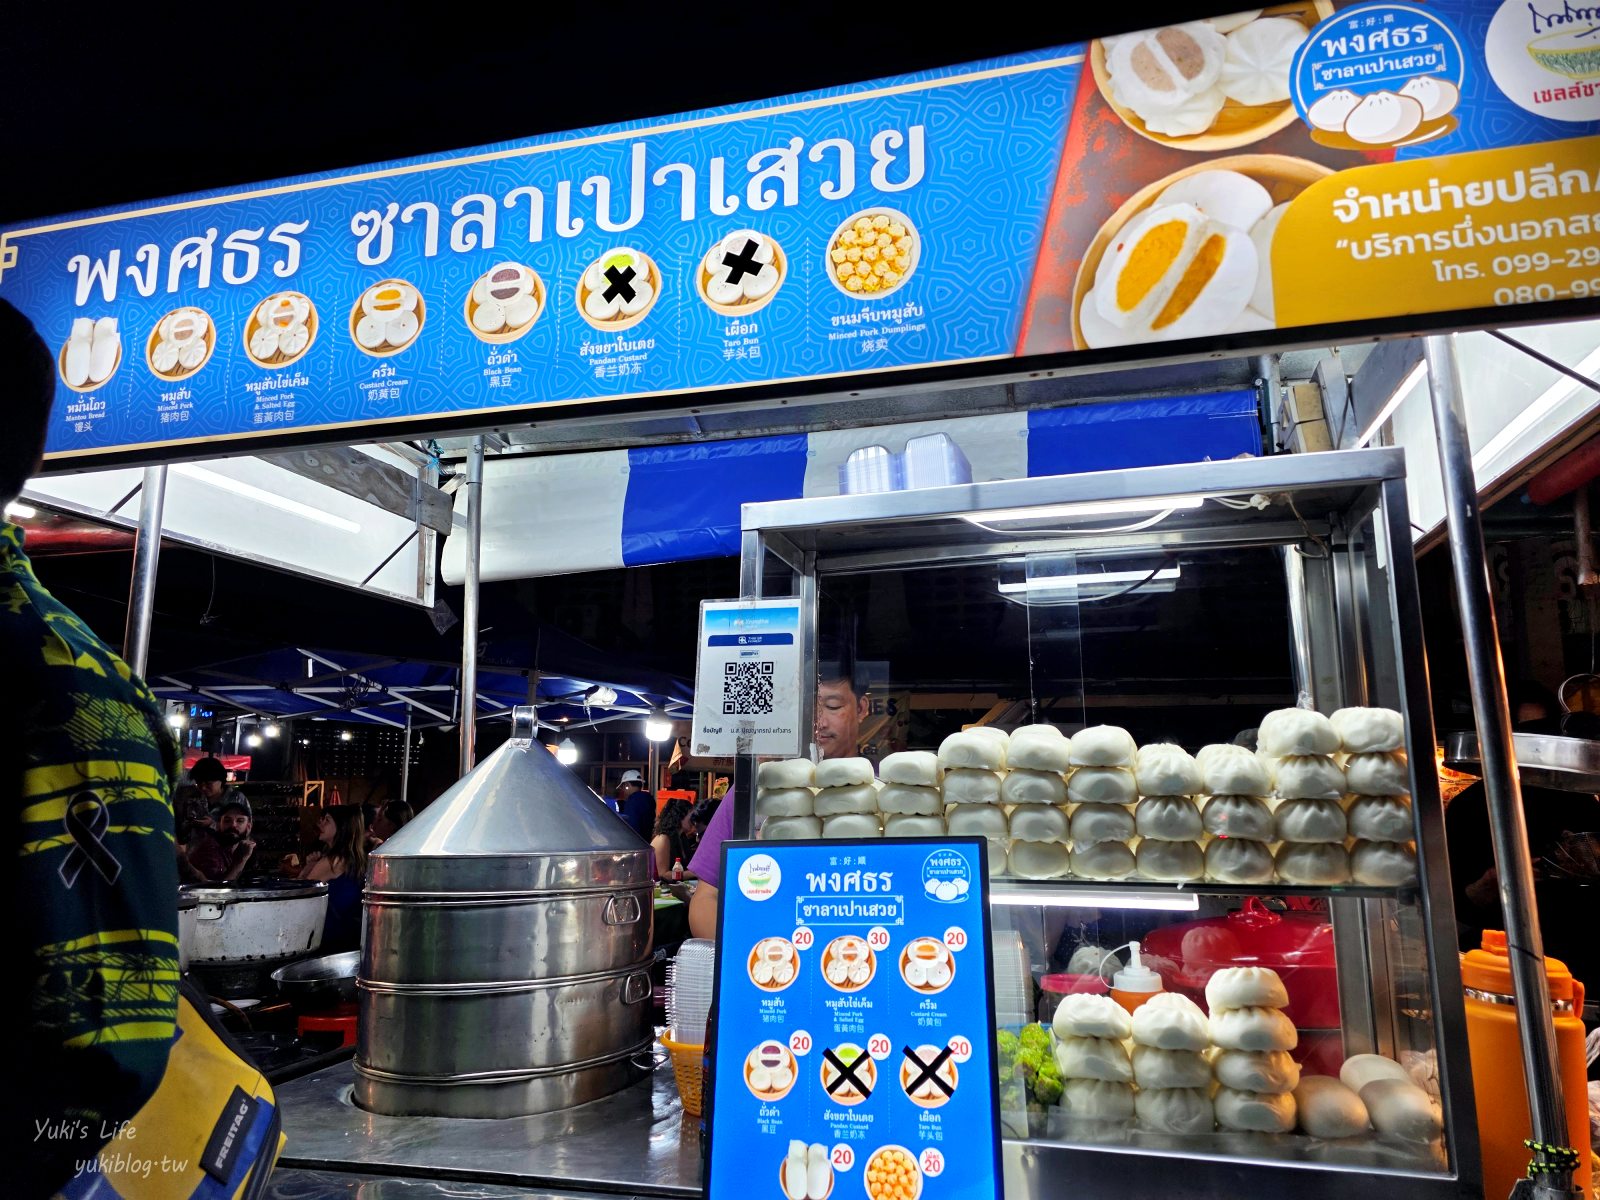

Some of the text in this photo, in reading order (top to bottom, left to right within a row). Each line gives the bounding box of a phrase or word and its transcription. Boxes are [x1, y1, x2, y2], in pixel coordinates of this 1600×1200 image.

[1321, 24, 1429, 58] พงศธร
[67, 124, 925, 307] พงศธร ซาลาเปาเสวย
[1432, 258, 1486, 283] โทร.
[831, 301, 923, 327] ขนมจีบหมูสับ
[725, 320, 758, 337] เผือก
[828, 323, 926, 341] Minced Pork Dumplings
[579, 335, 655, 357] สังขยาใบเตย
[723, 337, 759, 347] Taro Bun
[487, 346, 518, 365] ถั่วดำ
[589, 353, 648, 366] Pandan Custard
[723, 346, 761, 361] 芋头包
[372, 363, 396, 379] ครีม
[483, 366, 522, 376] Black Bean
[359, 379, 409, 390] Custard Cream
[489, 375, 512, 388] 黑豆
[160, 386, 191, 405] หมูสับ
[255, 392, 295, 403] Minced Pork
[157, 402, 194, 412] Minced Pork
[262, 401, 281, 410] Salted
[283, 400, 296, 409] Egg
[805, 869, 894, 893] พงศธร
[795, 932, 811, 944] 20
[870, 932, 888, 945] 30
[947, 932, 965, 945] 20
[792, 1036, 810, 1050] 20
[871, 1039, 889, 1053] 20
[950, 1041, 969, 1055] 20
[215, 1102, 249, 1169] FREITAG
[833, 1149, 851, 1164] 20
[924, 1159, 941, 1173] 20
